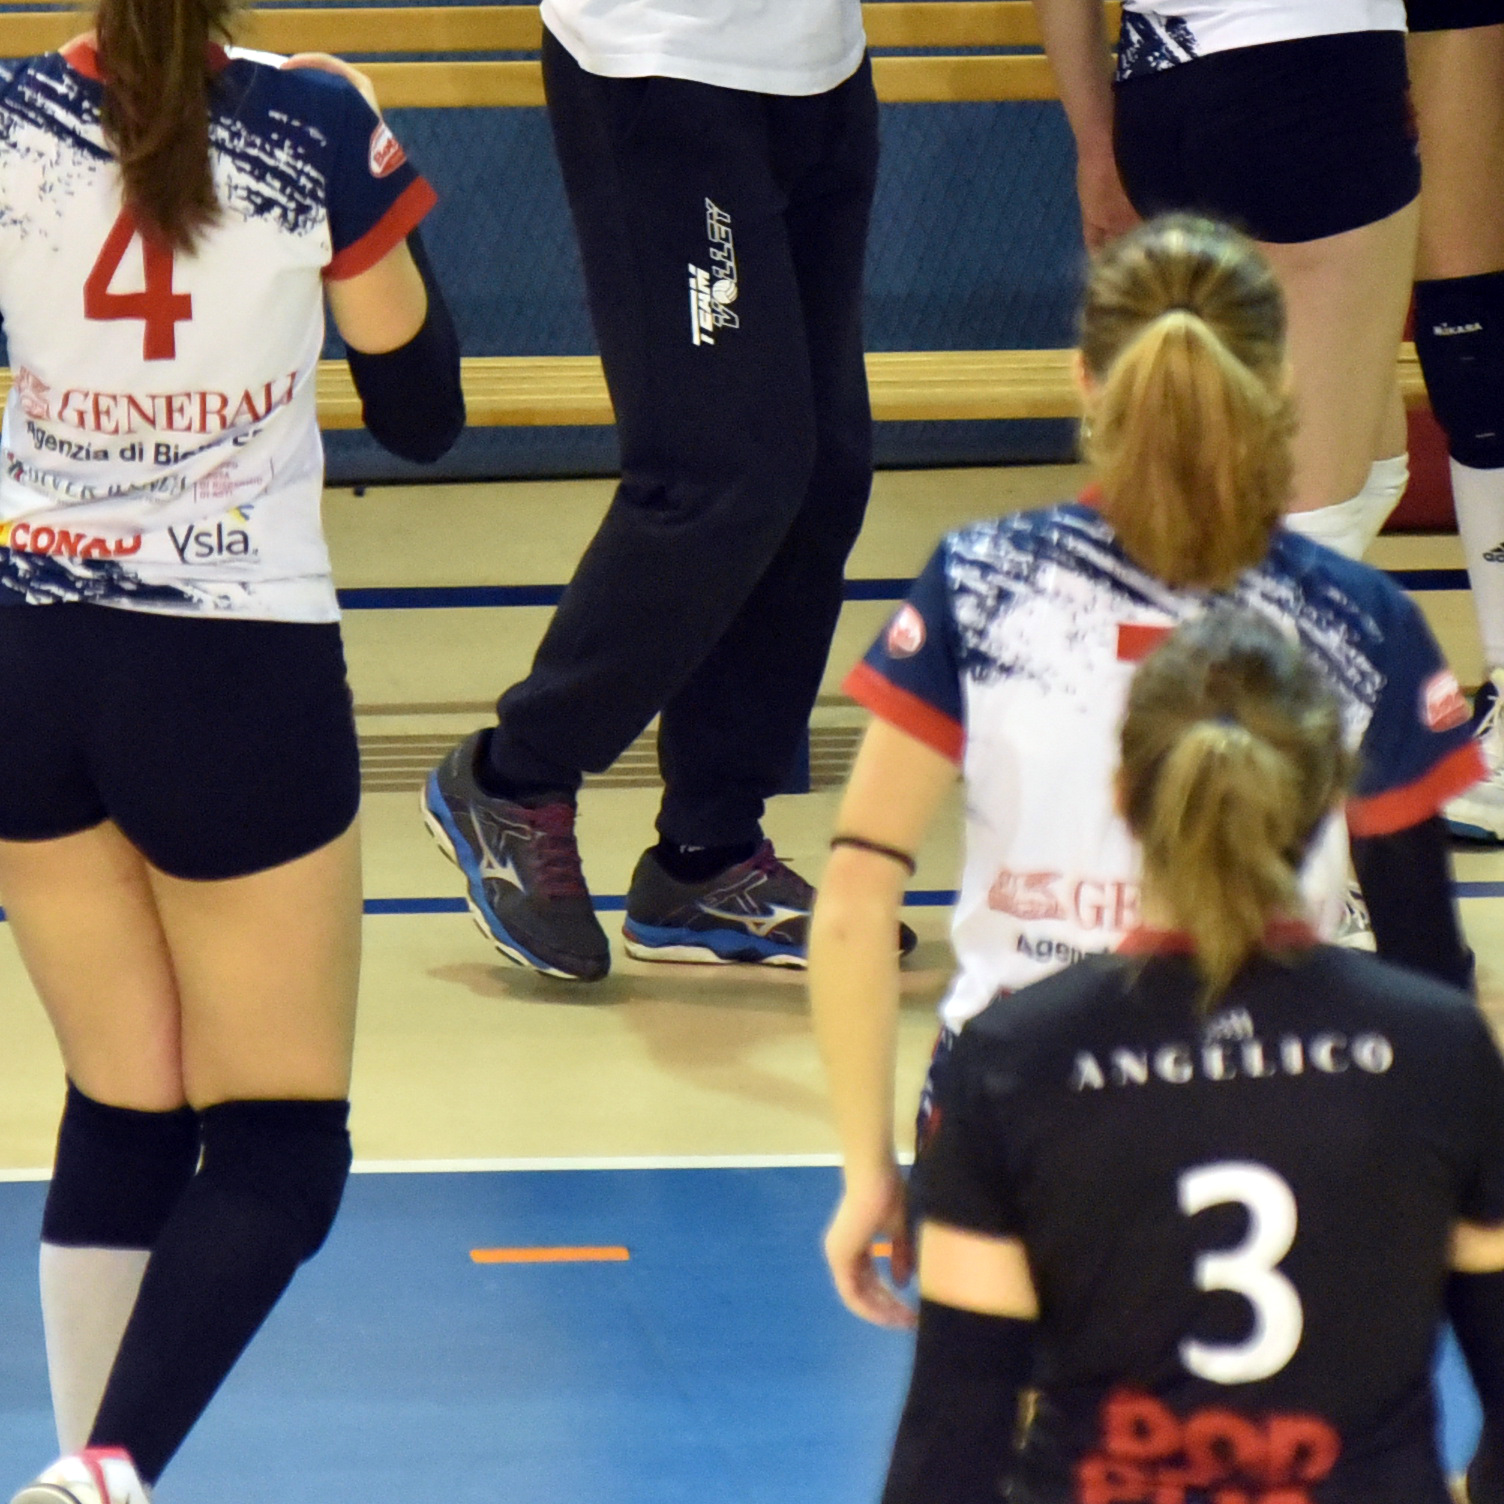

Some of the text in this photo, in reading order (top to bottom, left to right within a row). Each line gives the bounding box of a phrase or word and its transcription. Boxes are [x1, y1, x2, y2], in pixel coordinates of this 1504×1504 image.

[83, 206, 193, 361] 4
[27, 420, 109, 462] Agenzia
[119, 442, 144, 463] di
[168, 522, 250, 564] Ysla
[1071, 1031, 1395, 1092] ANGELICO
[1178, 1162, 1303, 1384] 3
